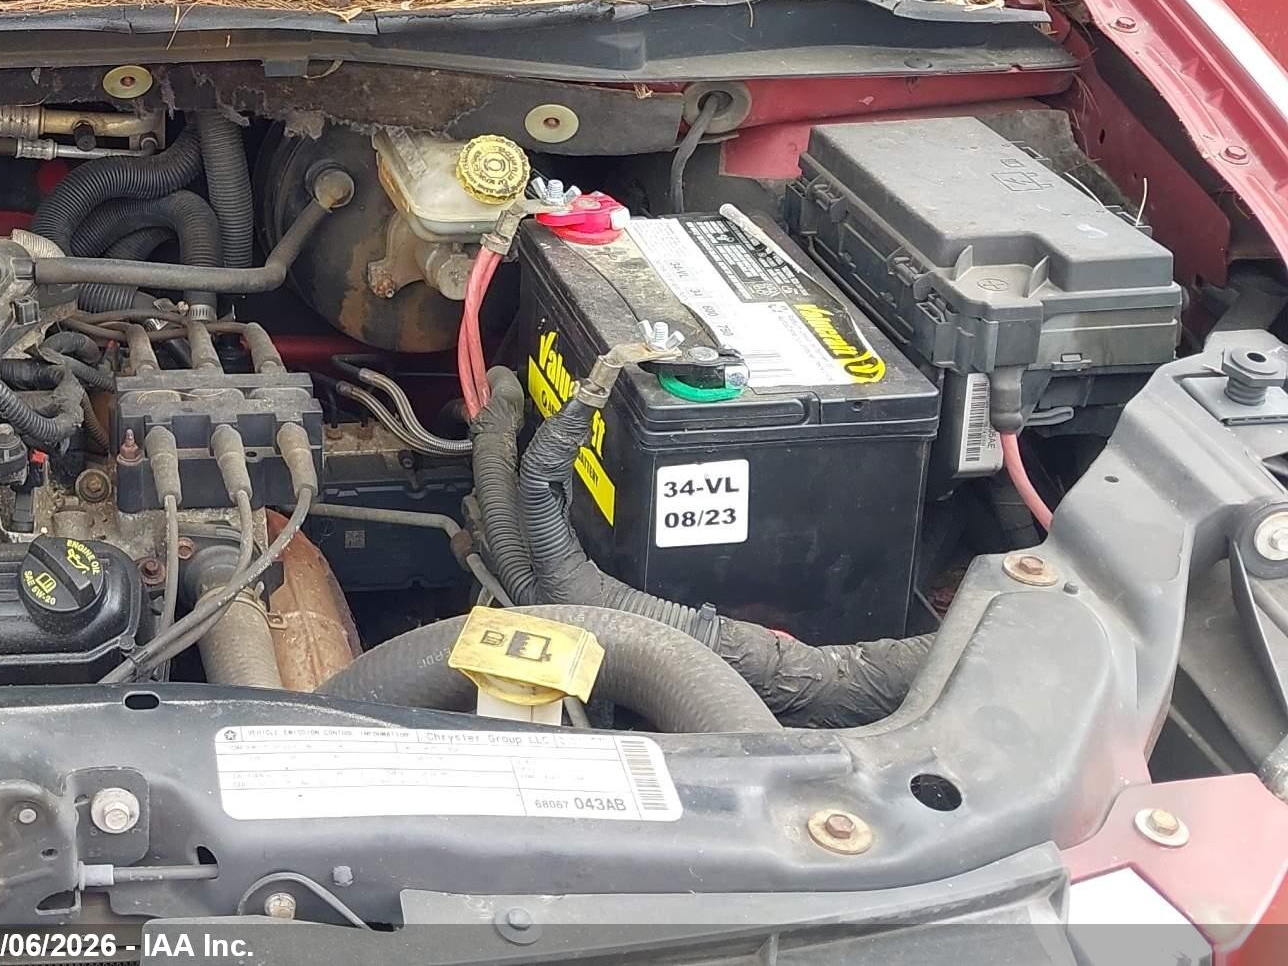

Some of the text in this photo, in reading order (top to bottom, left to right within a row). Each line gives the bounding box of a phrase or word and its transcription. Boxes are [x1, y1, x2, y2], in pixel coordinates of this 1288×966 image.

[663, 476, 740, 498] 34-VL
[664, 507, 737, 529] 08/23
[66, 539, 103, 575] ENGINE OIL
[24, 570, 56, 605] SAE 5W-20
[248, 729, 278, 737] VEHICLE
[283, 729, 320, 737] EMISSION
[425, 732, 480, 746] Chrysler
[488, 734, 522, 746] Group
[528, 736, 549, 745] LLC
[573, 797, 627, 812] 043AB
